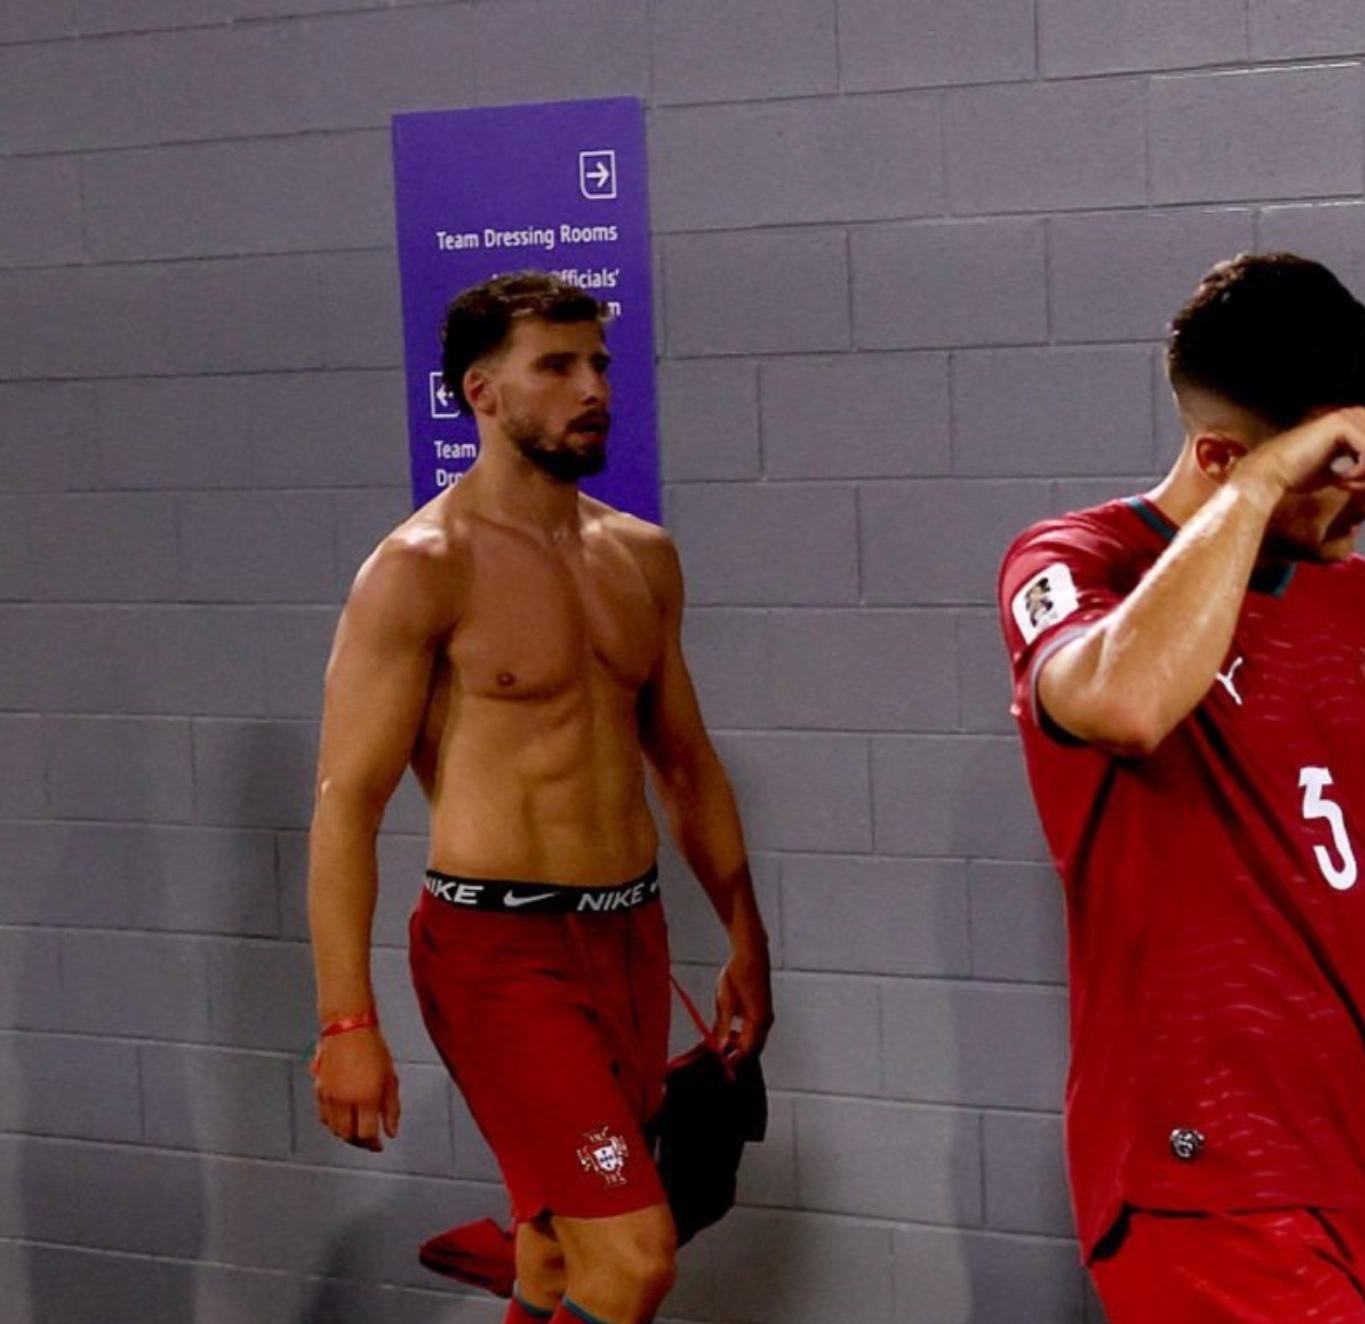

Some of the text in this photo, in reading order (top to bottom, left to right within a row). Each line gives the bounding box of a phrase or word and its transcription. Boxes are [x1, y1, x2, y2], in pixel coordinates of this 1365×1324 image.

[436, 224, 618, 249] Team Dressing Rooms
[552, 268, 619, 289] fficials'
[433, 440, 477, 459] Team
[1298, 766, 1358, 890] 5
[577, 883, 645, 911] NIKE
